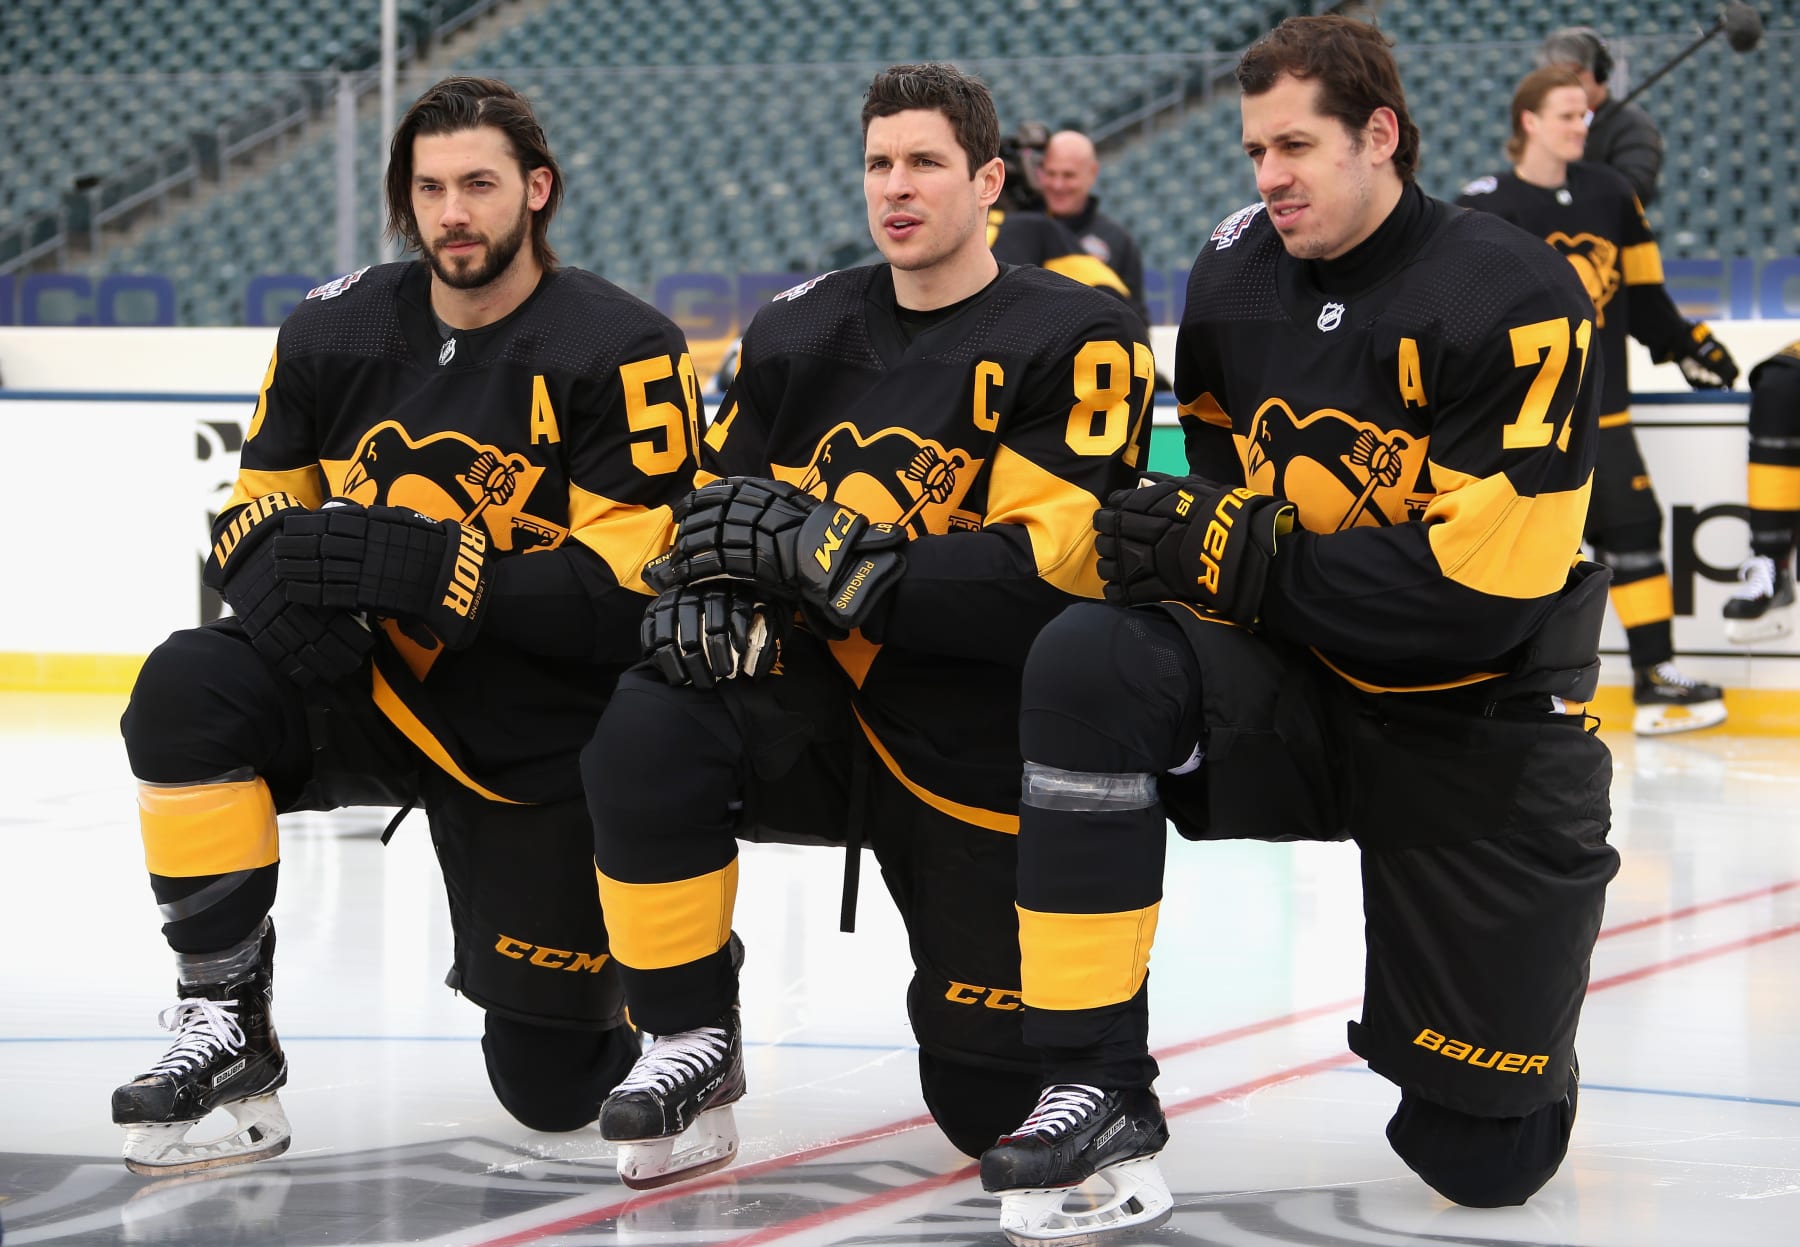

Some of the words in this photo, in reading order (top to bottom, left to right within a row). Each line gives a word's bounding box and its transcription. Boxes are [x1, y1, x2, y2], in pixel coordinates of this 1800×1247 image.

[973, 360, 1004, 433] C
[1065, 341, 1155, 468] 87
[1399, 338, 1428, 408] A
[530, 375, 561, 445] A
[442, 523, 486, 617] RIOR
[814, 507, 859, 574] CM
[836, 560, 875, 609] PENGUINS
[495, 933, 610, 974] CCM
[944, 980, 1026, 1012] CC
